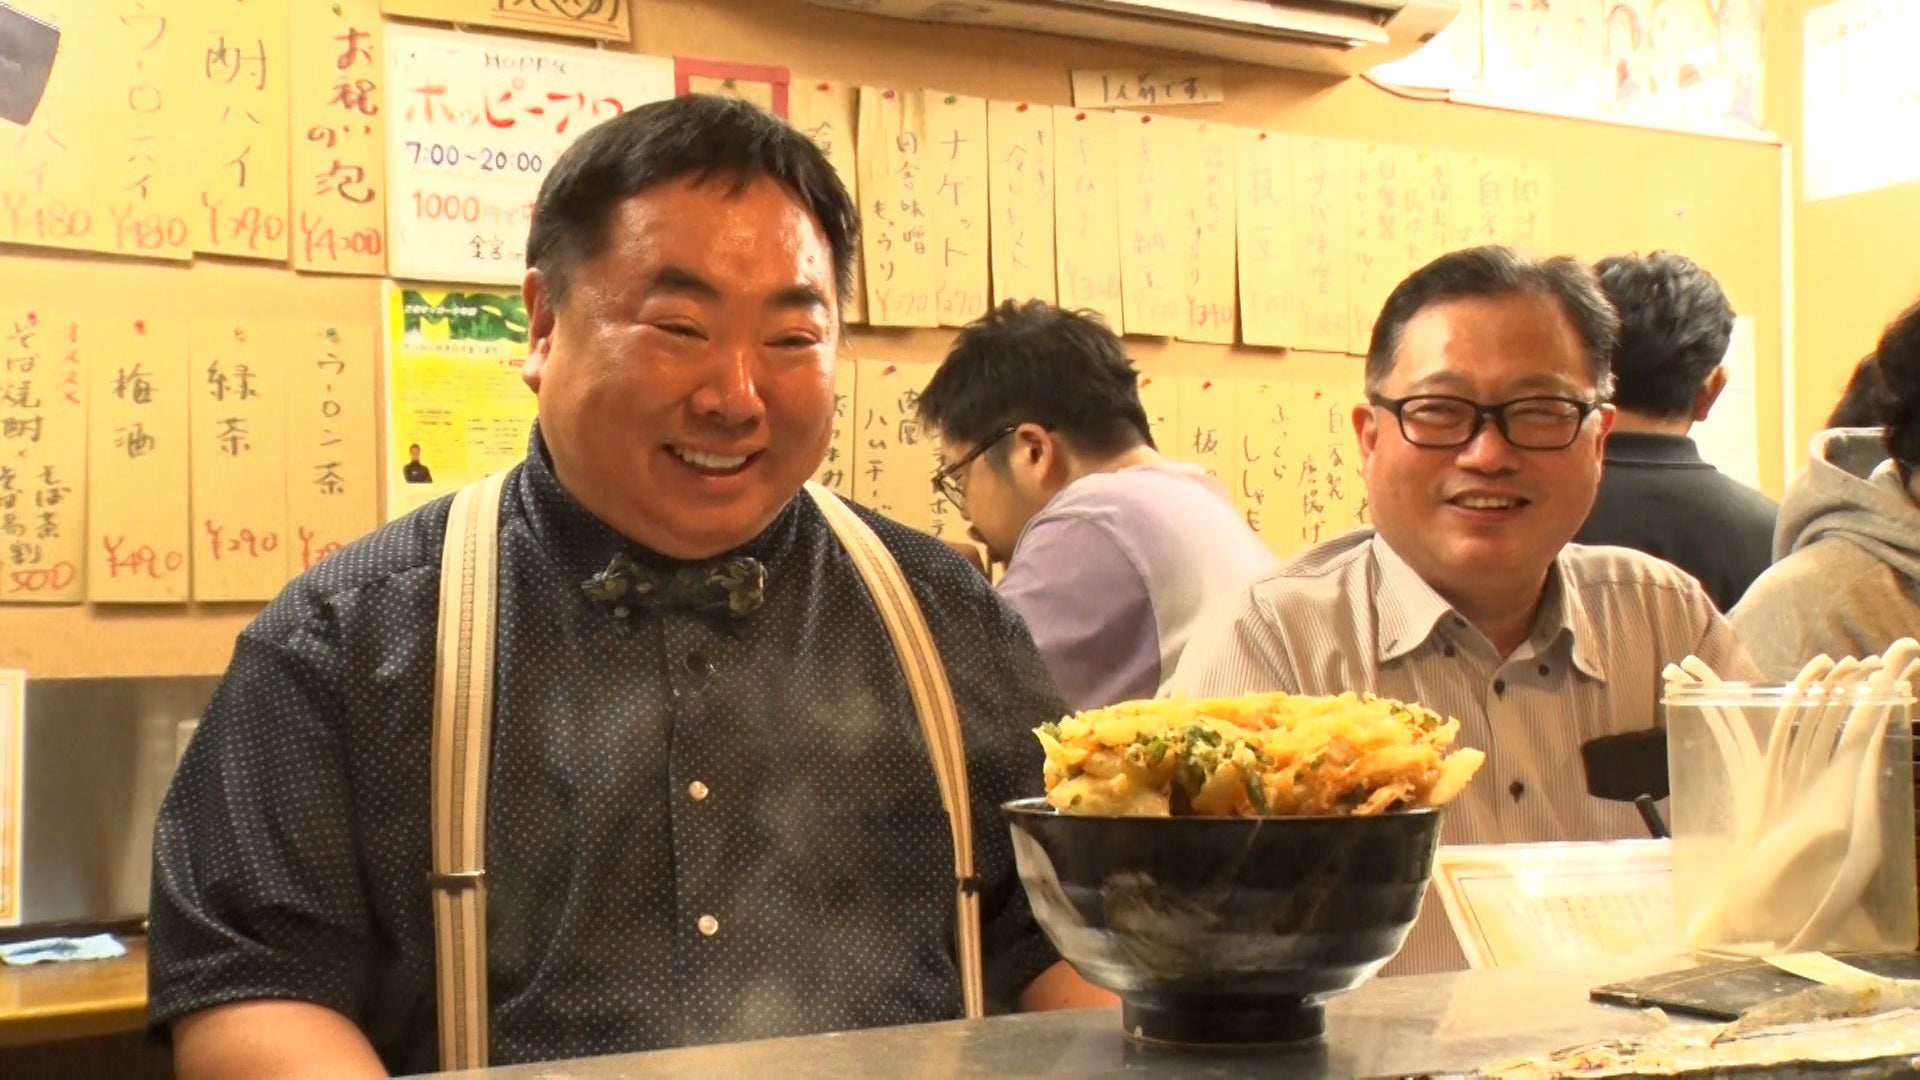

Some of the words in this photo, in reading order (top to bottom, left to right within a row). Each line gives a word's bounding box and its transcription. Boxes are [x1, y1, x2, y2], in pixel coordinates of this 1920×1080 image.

[936, 129, 972, 268] ナゲット
[110, 361, 159, 460] 梅酒
[206, 358, 260, 458] 緑茶
